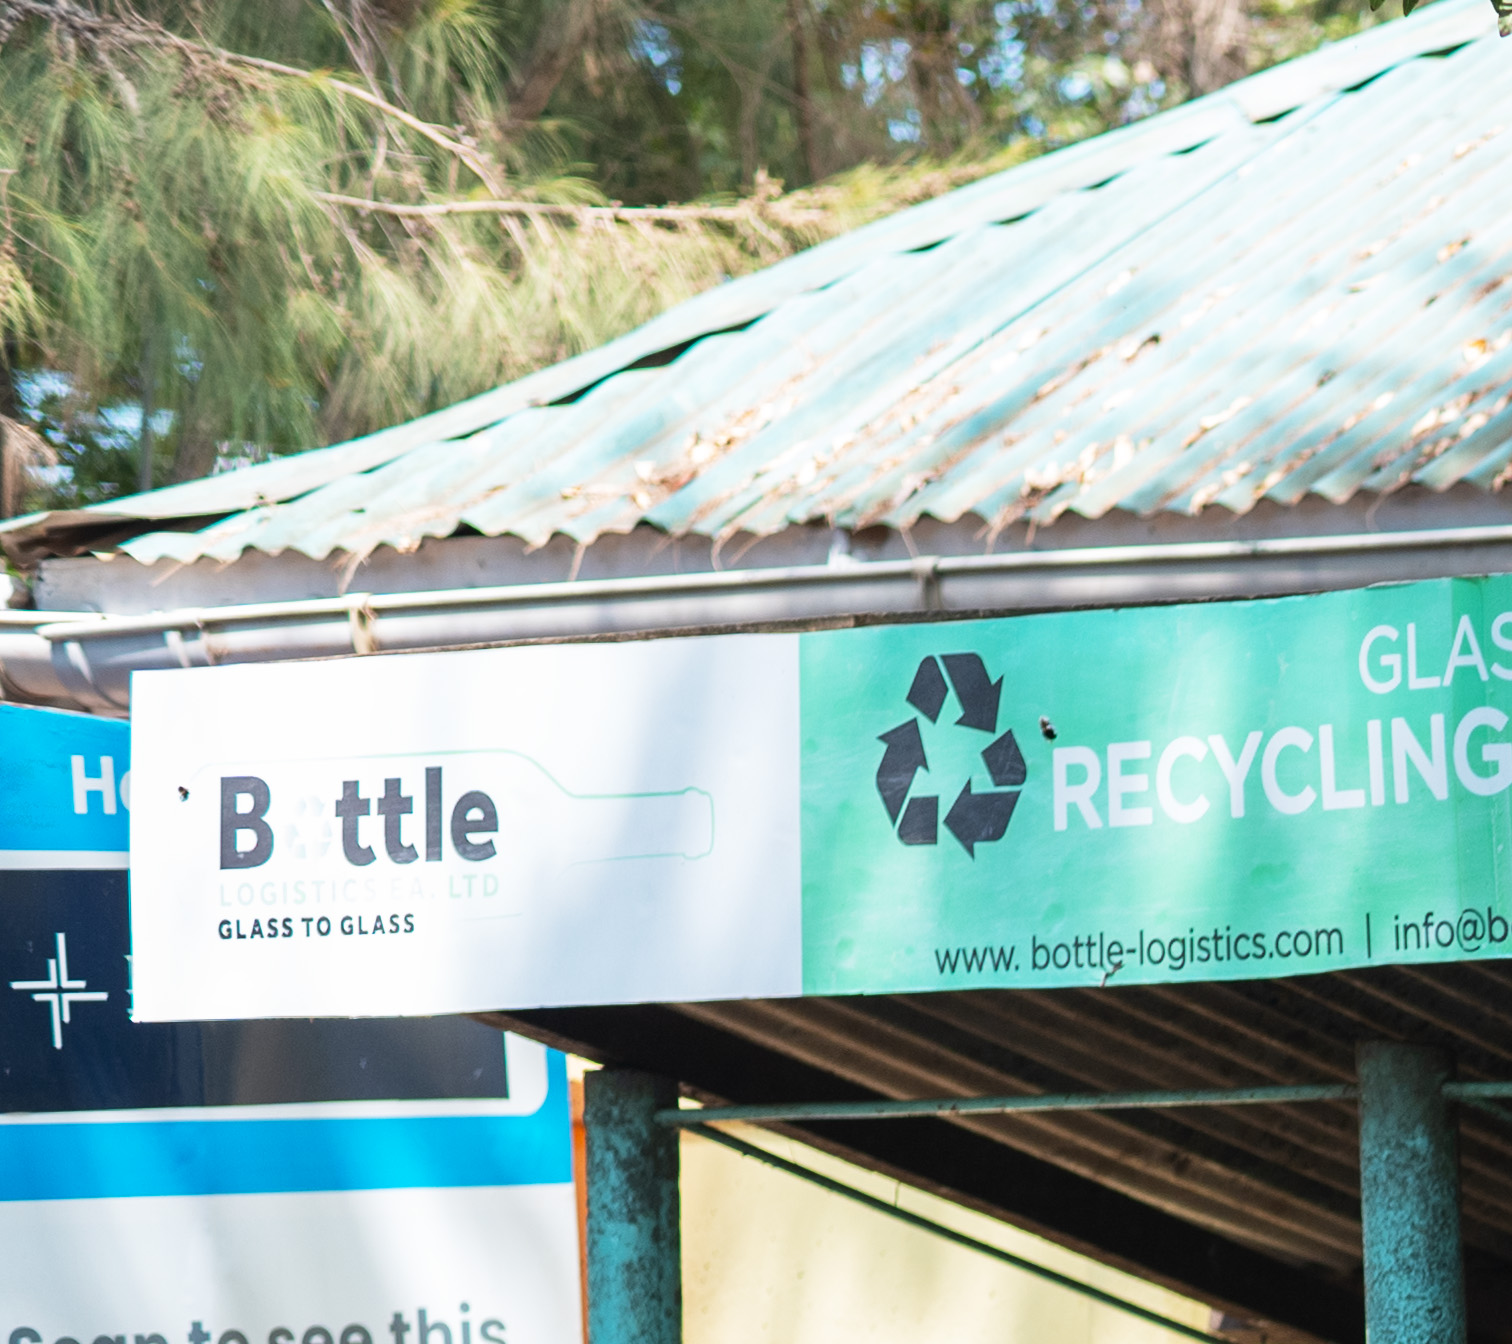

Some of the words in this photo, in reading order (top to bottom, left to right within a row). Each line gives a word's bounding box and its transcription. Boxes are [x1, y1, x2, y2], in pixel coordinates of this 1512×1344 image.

[218, 917, 292, 939] GLASS
[301, 916, 330, 936] TO
[340, 913, 414, 935] GLASS
[935, 946, 1018, 973] www.
[1032, 925, 1343, 972] bottle-logistics.com
